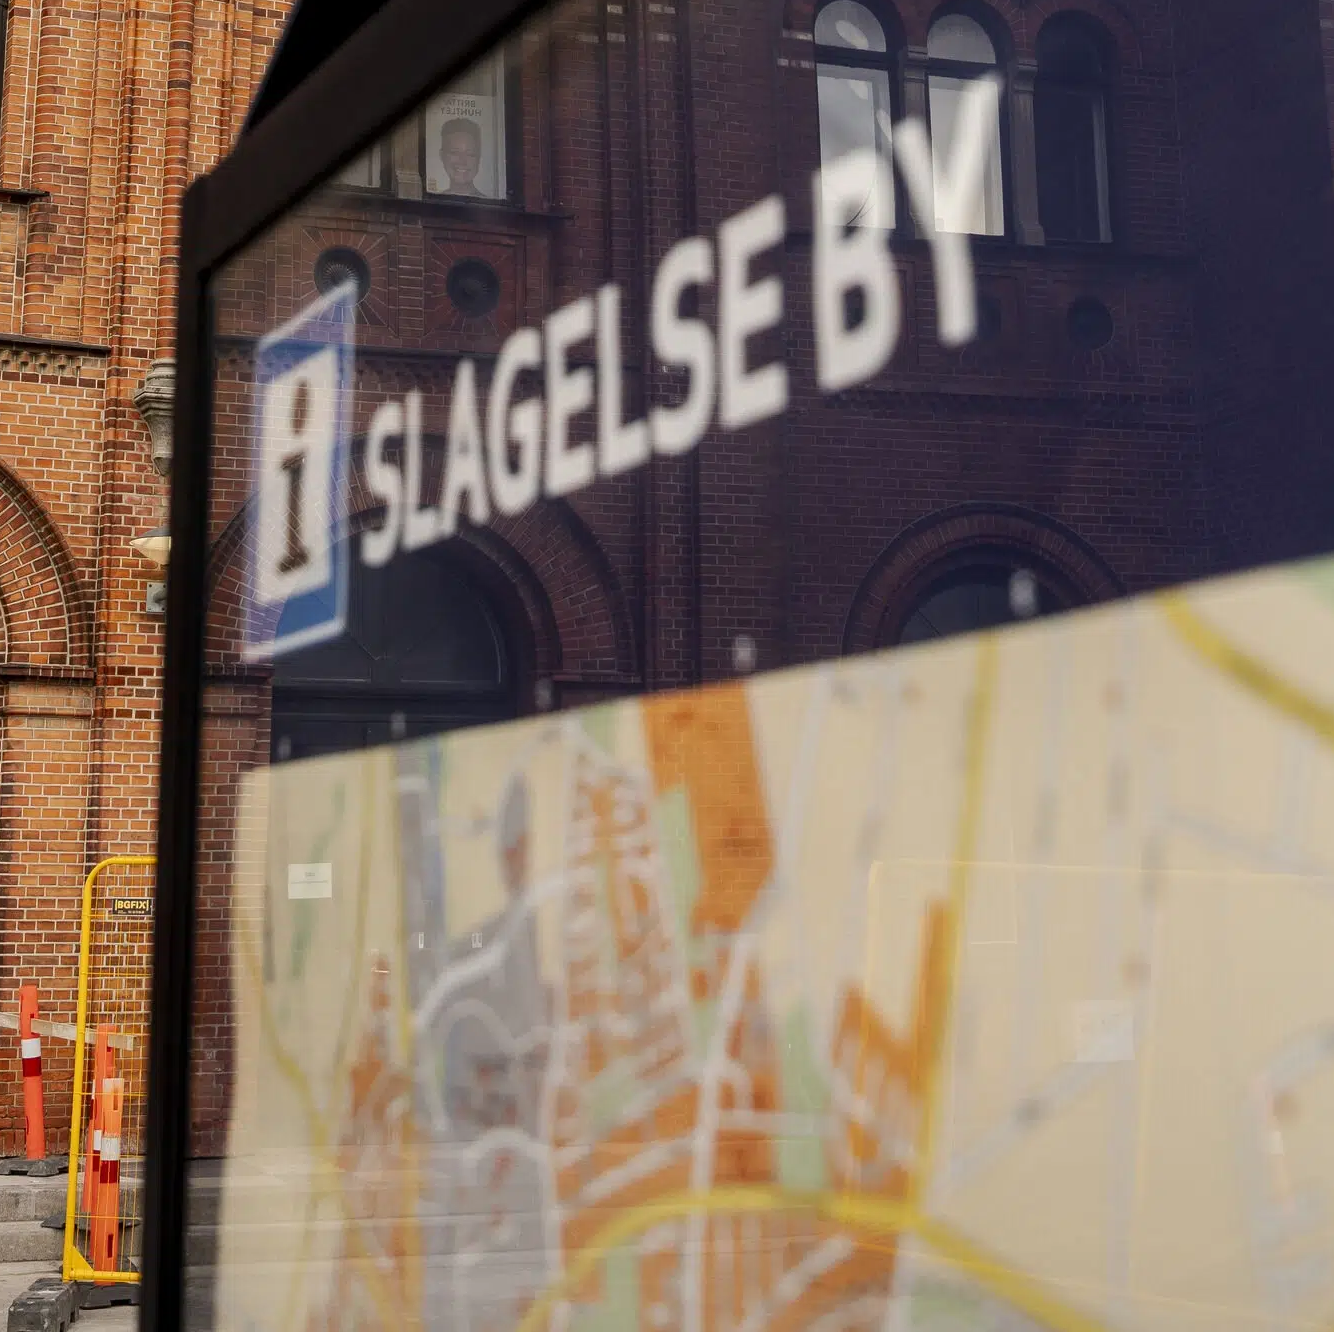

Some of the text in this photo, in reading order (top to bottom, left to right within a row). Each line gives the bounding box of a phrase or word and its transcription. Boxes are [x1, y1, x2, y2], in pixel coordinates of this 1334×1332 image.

[360, 71, 1003, 568] SLAGELSE BY
[117, 900, 146, 909] BGFIX
